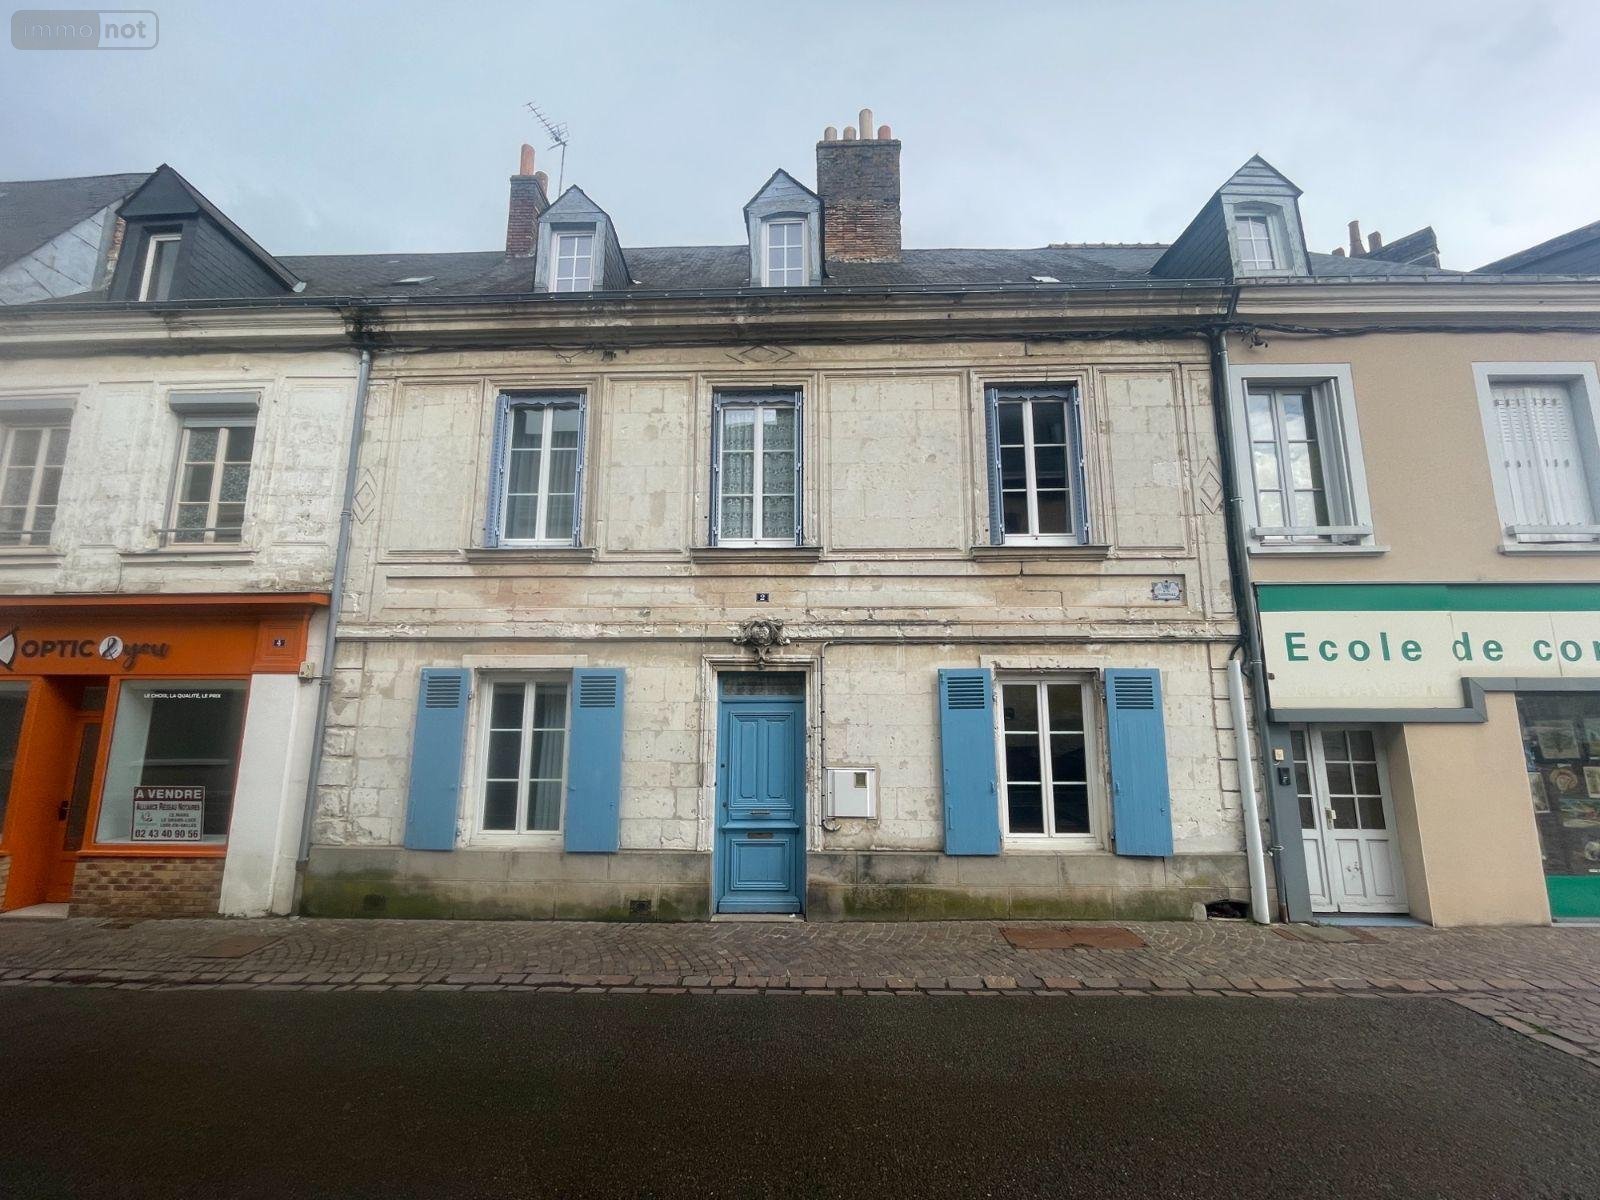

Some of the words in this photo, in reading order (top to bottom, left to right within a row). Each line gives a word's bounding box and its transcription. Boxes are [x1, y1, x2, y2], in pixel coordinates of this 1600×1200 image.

[21, 639, 95, 658] OPTIC
[122, 642, 169, 671] you
[1284, 632, 1423, 662] Ecole
[1452, 631, 1504, 662] de
[136, 789, 145, 799] A
[147, 789, 202, 799] VENDRE
[135, 829, 146, 838] 02
[148, 829, 159, 838] 43
[161, 829, 173, 838] 40
[174, 829, 186, 838] 90
[187, 829, 199, 838] 56
